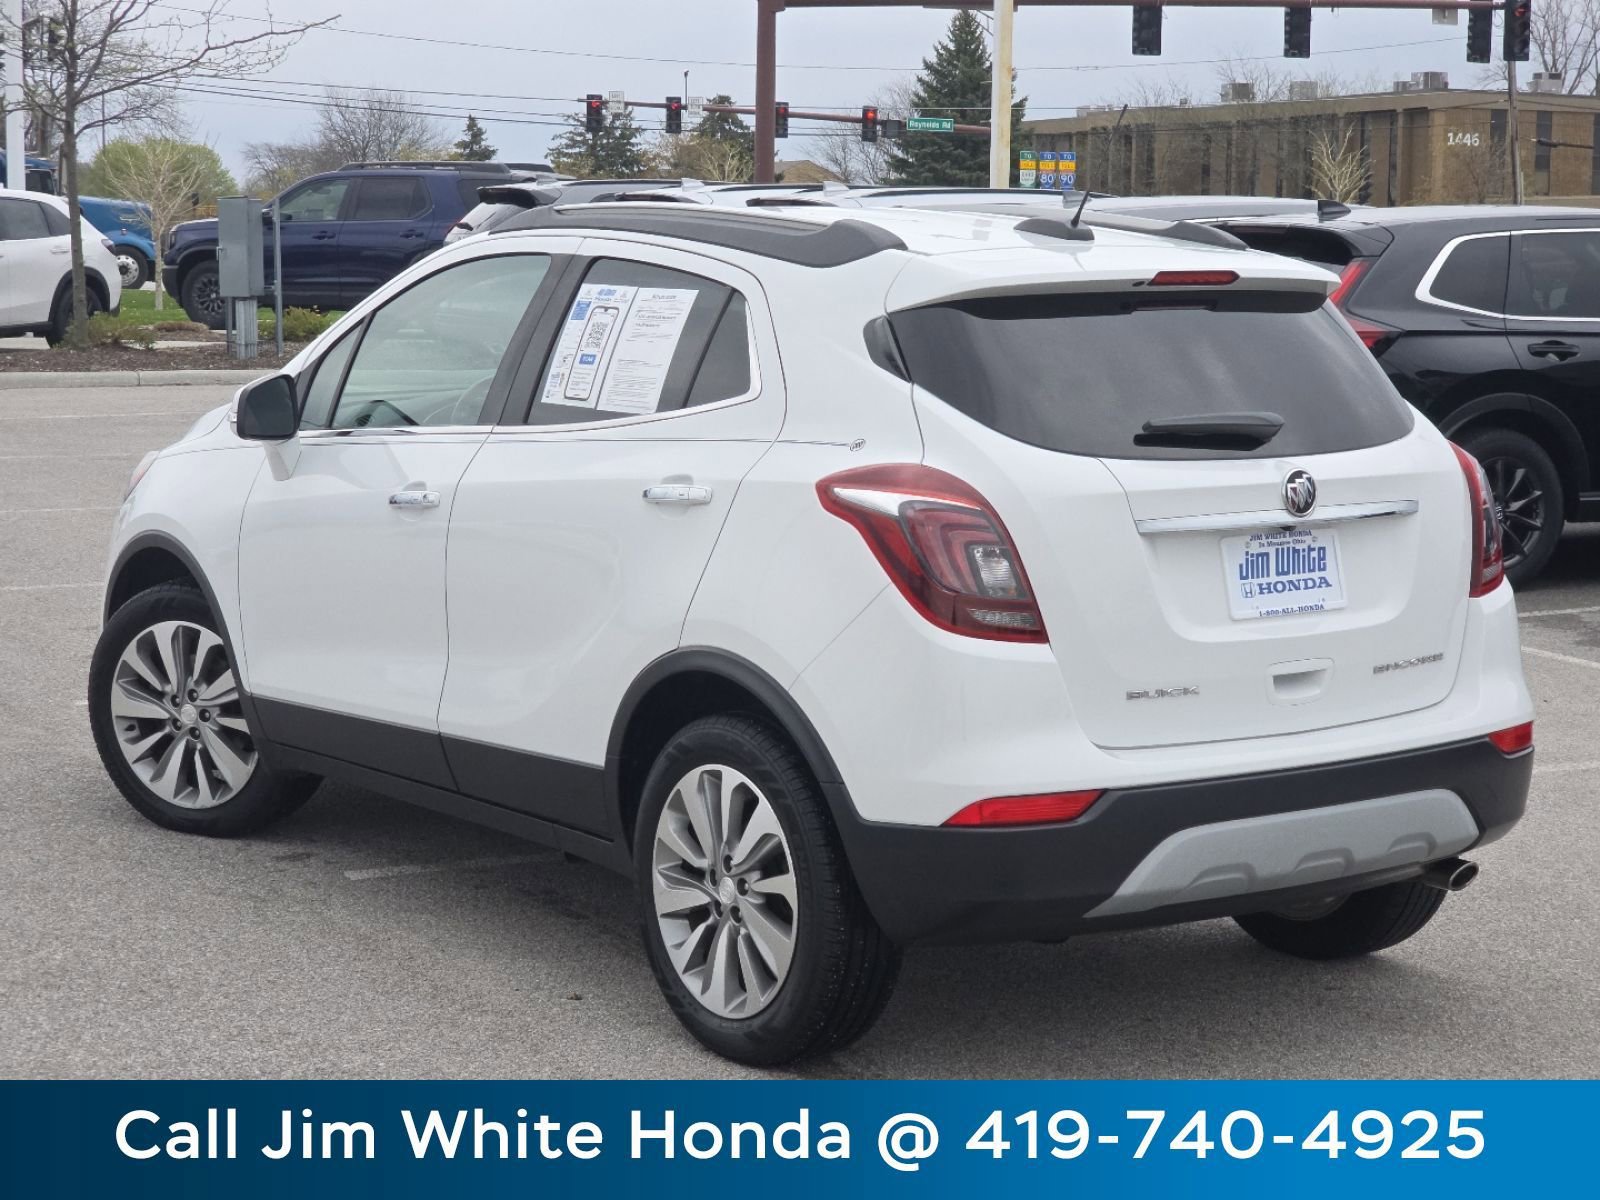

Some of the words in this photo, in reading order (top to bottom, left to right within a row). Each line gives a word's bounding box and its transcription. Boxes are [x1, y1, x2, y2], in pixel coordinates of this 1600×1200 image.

[942, 121, 951, 129] Rd
[1447, 132, 1480, 146] 1446
[1040, 174, 1054, 183] 80
[1060, 174, 1074, 184] 90
[1250, 533, 1263, 541] JIM
[1265, 531, 1288, 540] WHITE
[1289, 529, 1313, 538] HONDA
[1275, 544, 1327, 577] White
[1257, 577, 1332, 595] HONDA
[1372, 652, 1445, 675] ENCORE
[1125, 685, 1200, 701] BUICK
